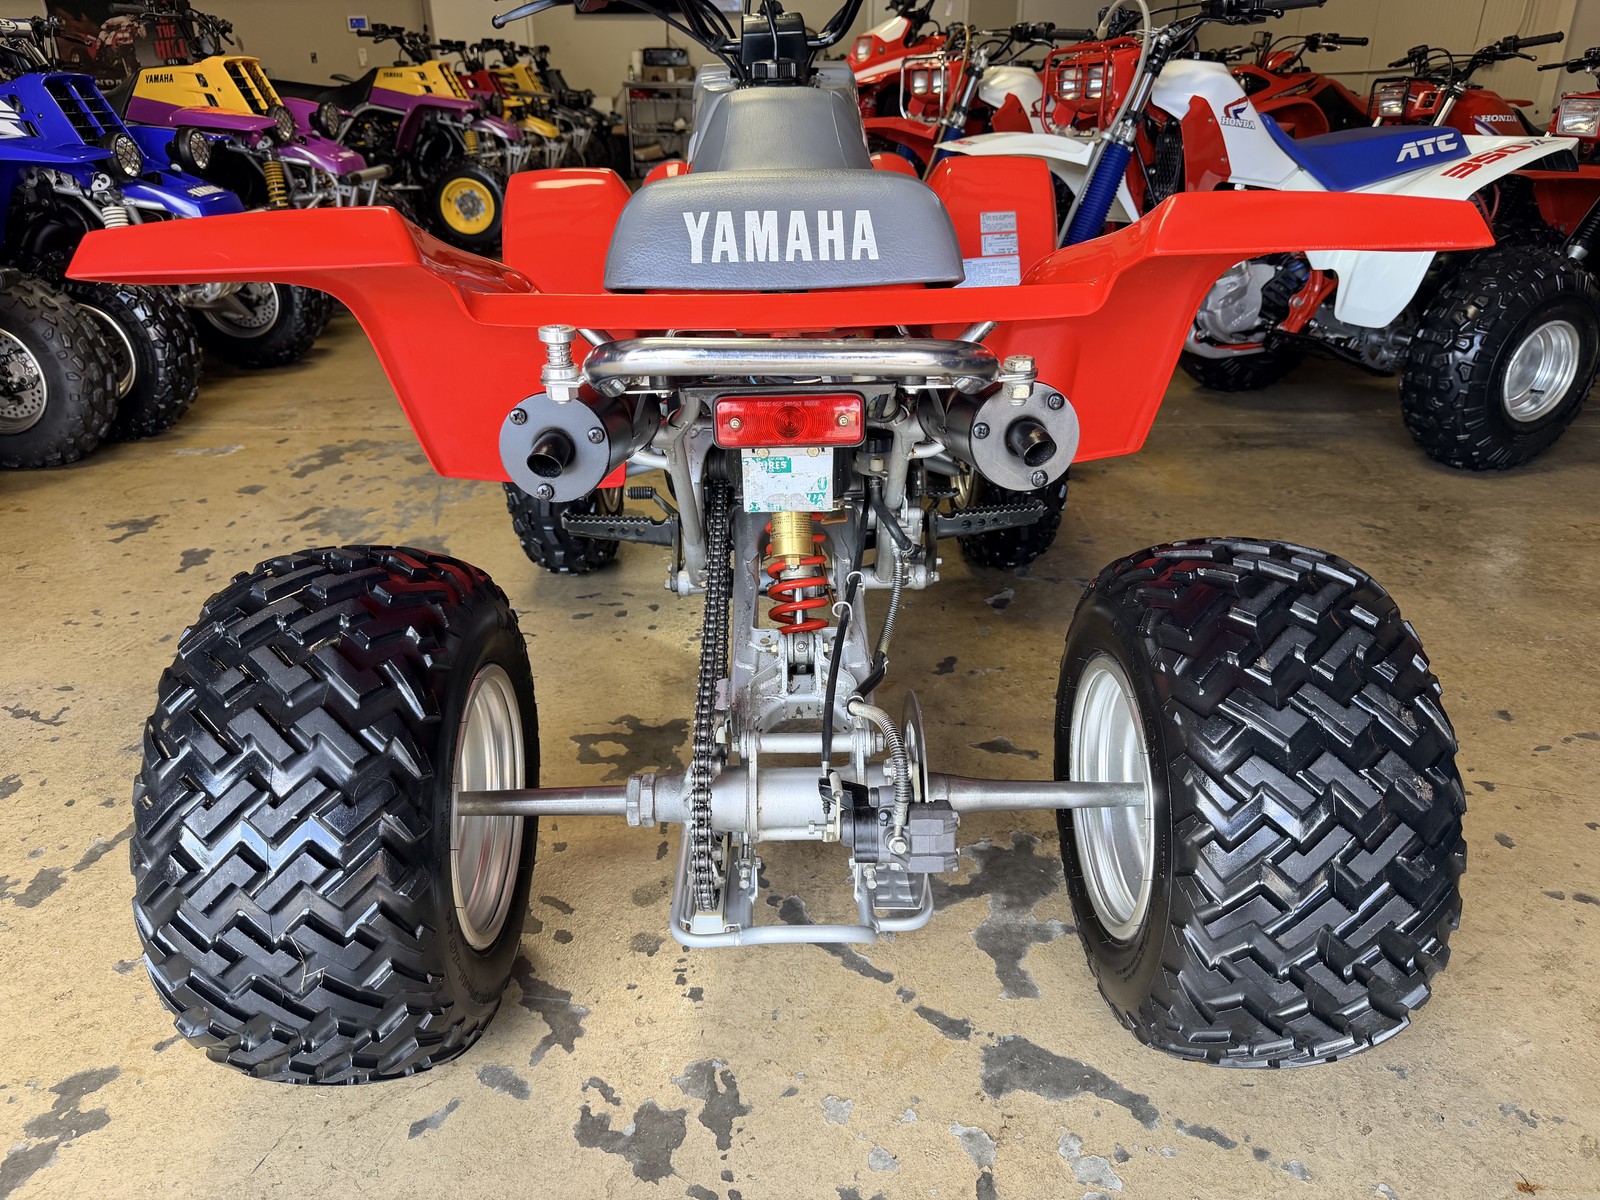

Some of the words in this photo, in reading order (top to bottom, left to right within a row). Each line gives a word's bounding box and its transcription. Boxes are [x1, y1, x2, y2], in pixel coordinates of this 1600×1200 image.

[155, 24, 176, 38] THE
[153, 38, 189, 59] HILL
[145, 73, 174, 84] YAMAHA
[1221, 116, 1256, 130] HONDA
[1480, 114, 1518, 123] HONDA
[1396, 132, 1459, 163] ATC
[682, 209, 880, 264] YAMAHA
